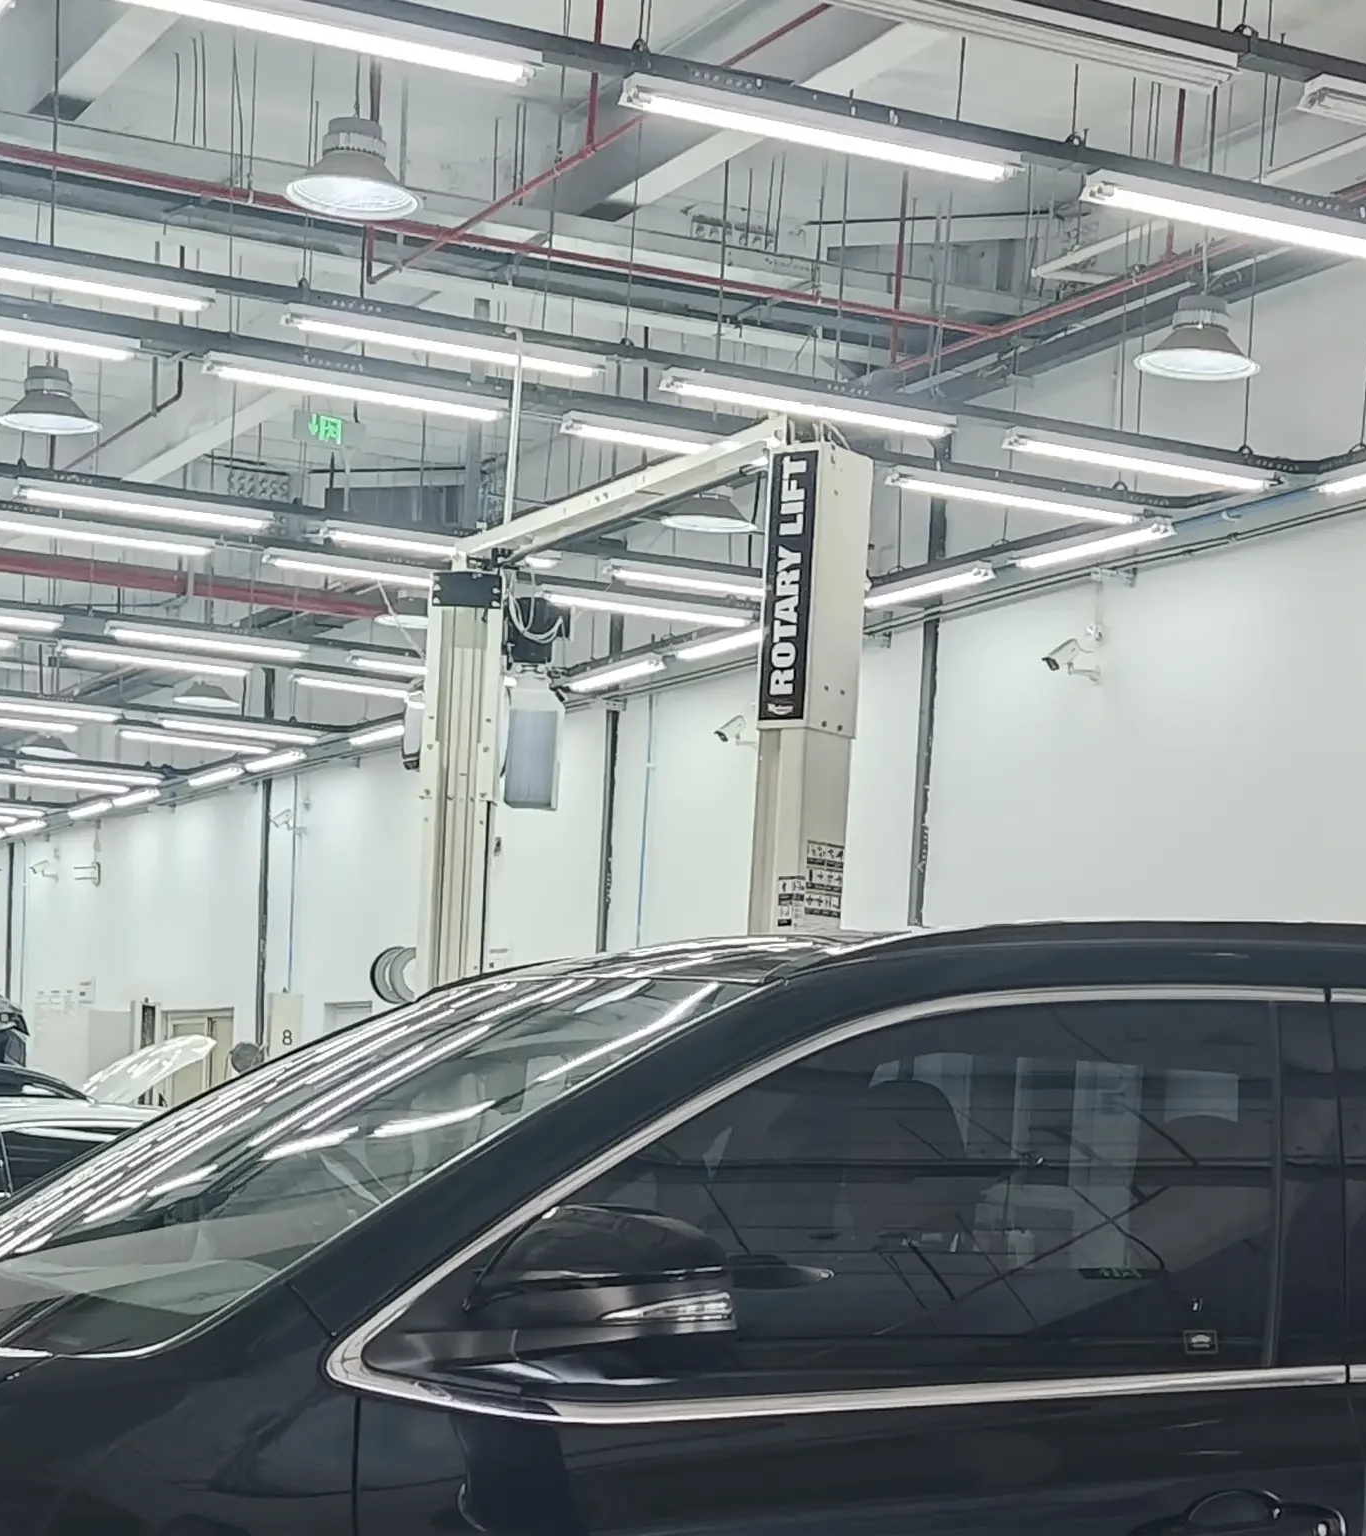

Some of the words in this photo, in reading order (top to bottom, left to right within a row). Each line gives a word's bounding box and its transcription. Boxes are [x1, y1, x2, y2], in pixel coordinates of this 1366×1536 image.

[779, 455, 807, 536] LIFT
[769, 545, 802, 696] ROTARY
[282, 1029, 293, 1045] 8
